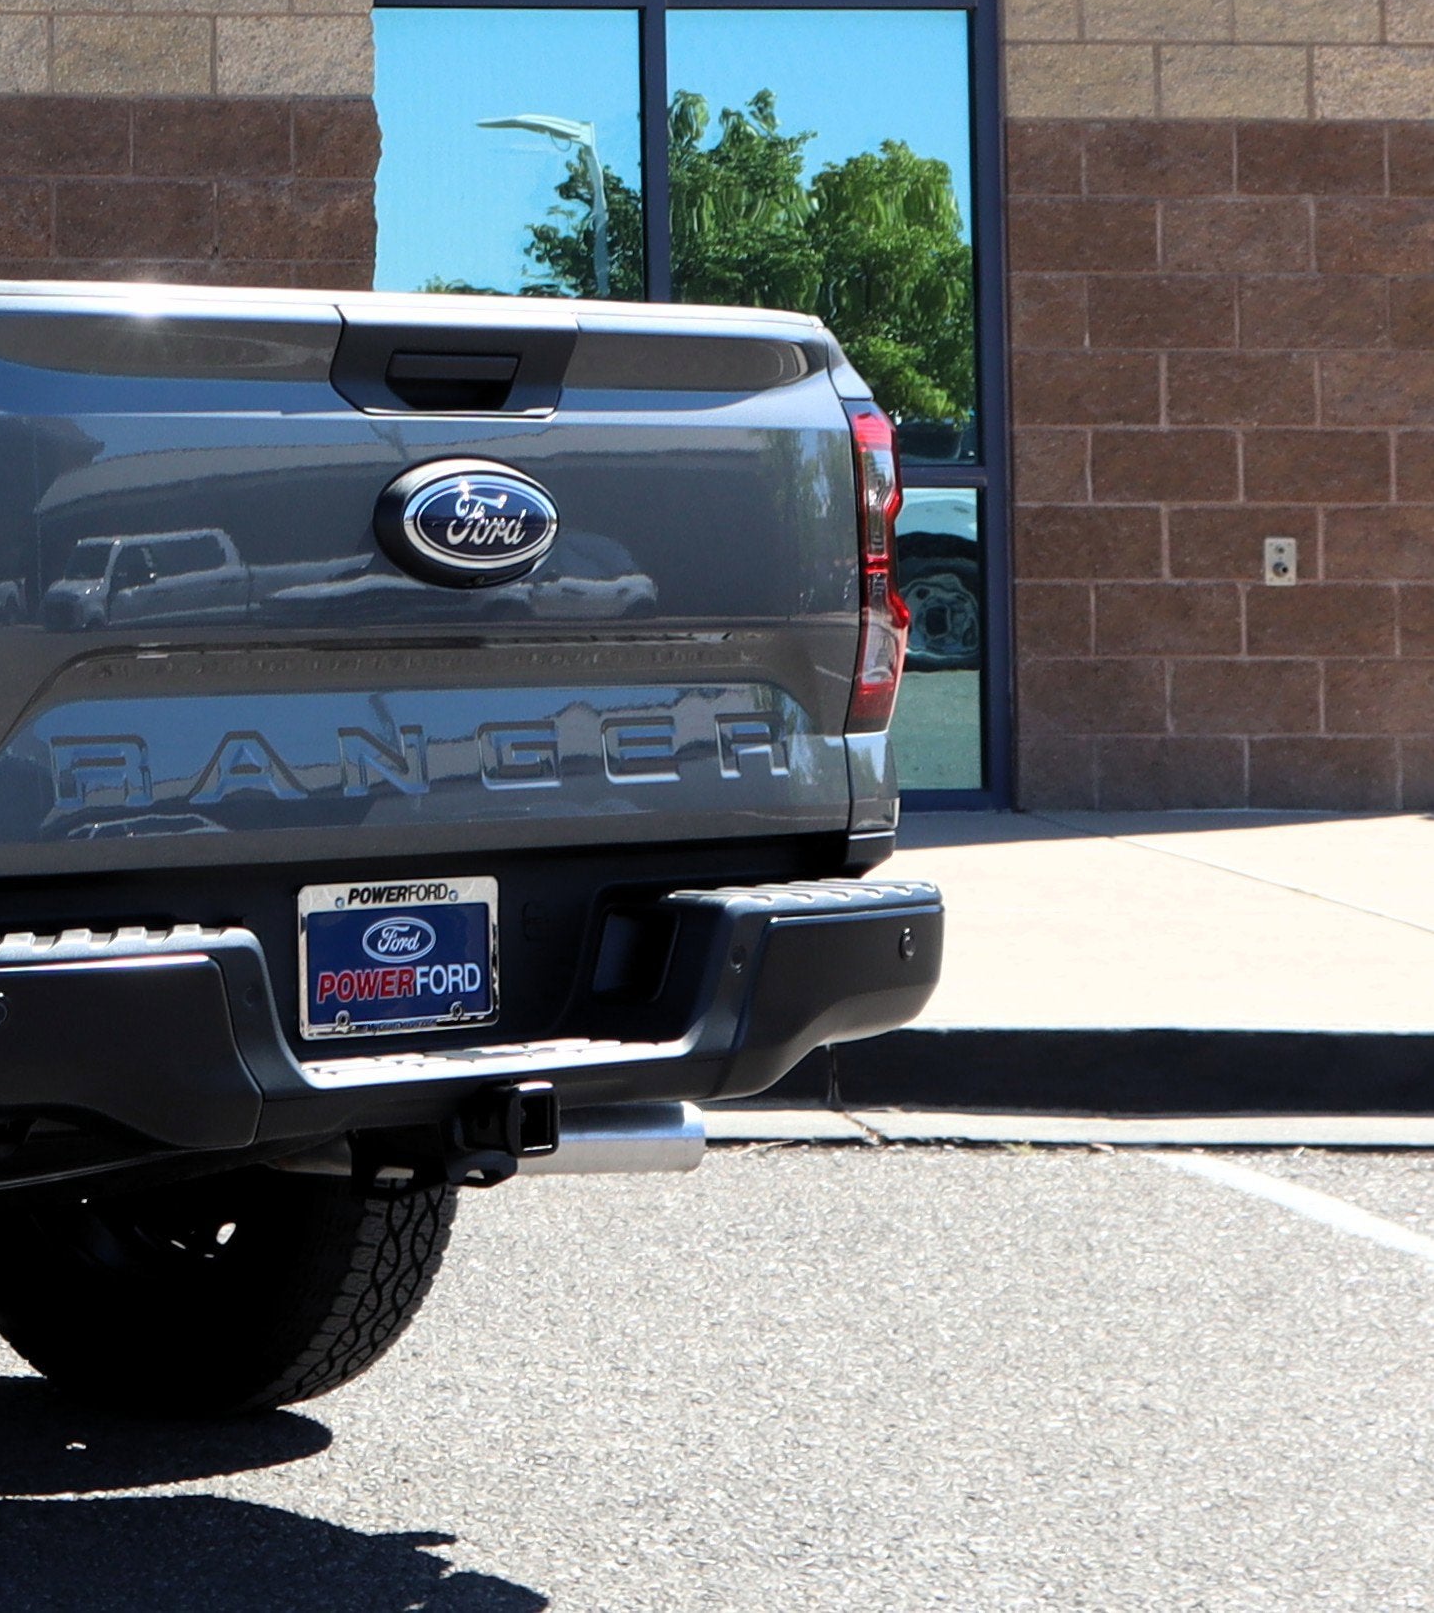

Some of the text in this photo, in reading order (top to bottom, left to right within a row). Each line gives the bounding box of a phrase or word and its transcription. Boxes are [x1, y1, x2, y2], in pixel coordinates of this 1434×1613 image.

[446, 493, 527, 546] Ford
[50, 712, 790, 808] RANGER
[377, 925, 421, 954] Ford
